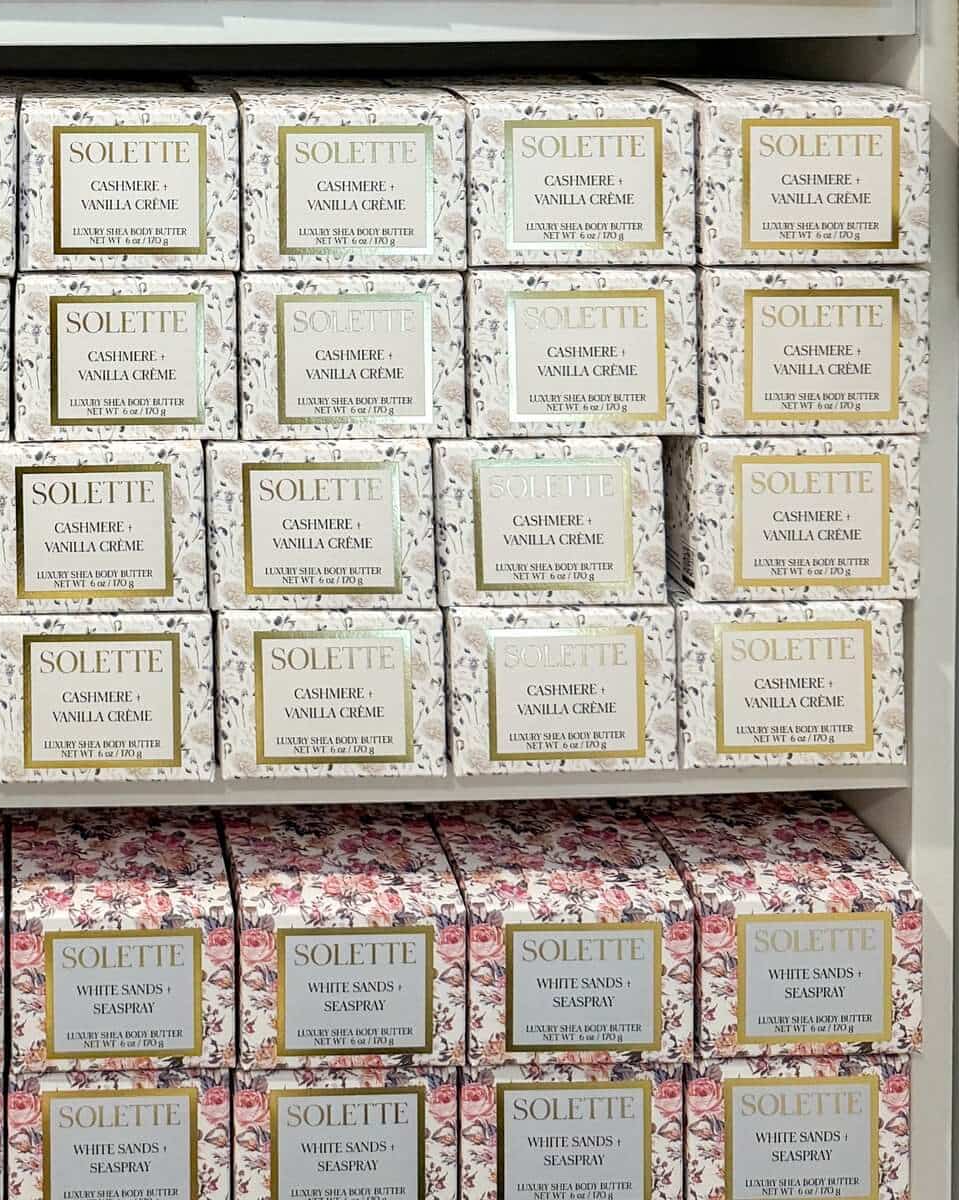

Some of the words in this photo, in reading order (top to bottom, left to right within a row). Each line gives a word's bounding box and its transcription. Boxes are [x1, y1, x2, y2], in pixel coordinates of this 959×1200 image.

[761, 304, 883, 328] SOLETTE
[784, 345, 853, 356] CASHMERE
[774, 364, 824, 375] VANILLA
[754, 559, 786, 567] LUXURY
[813, 558, 836, 566] BODY
[838, 558, 870, 566] BUTTER
[62, 944, 184, 969] SOLETTE
[77, 985, 119, 996] WHITE
[122, 984, 163, 995] SANDS
[93, 1002, 155, 1014] SEASPRAY
[741, 1092, 862, 1116] SOLETTE
[755, 1132, 797, 1144] WHITE
[800, 1131, 841, 1142] SANDS
[771, 1150, 832, 1162] SEASPRAY
